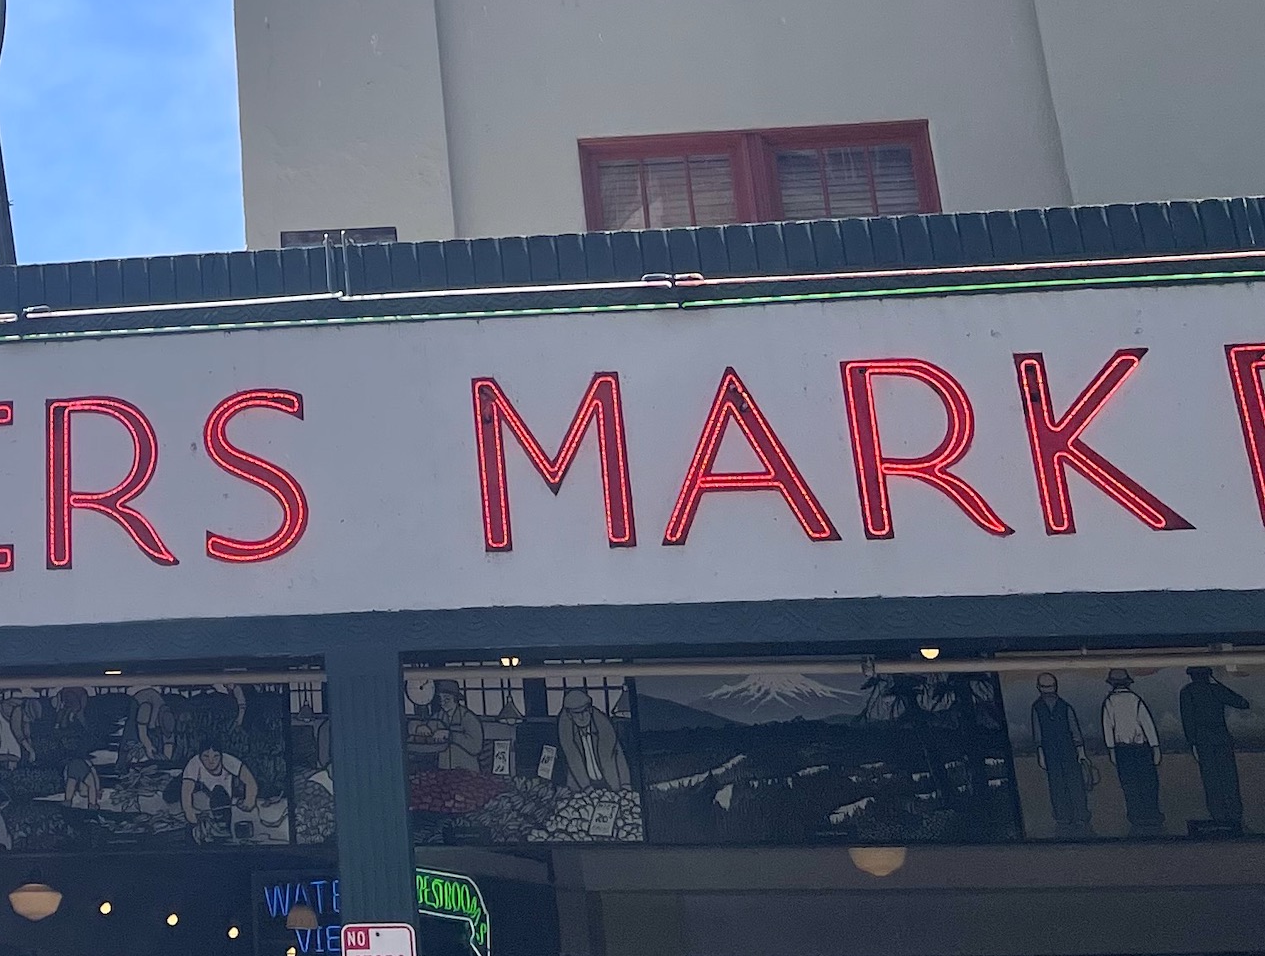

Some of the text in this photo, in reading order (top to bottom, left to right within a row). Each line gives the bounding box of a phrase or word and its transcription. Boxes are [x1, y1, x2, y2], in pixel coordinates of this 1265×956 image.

[263, 879, 340, 919] WATE
[294, 925, 341, 953] VIE
[346, 930, 366, 947] NO
